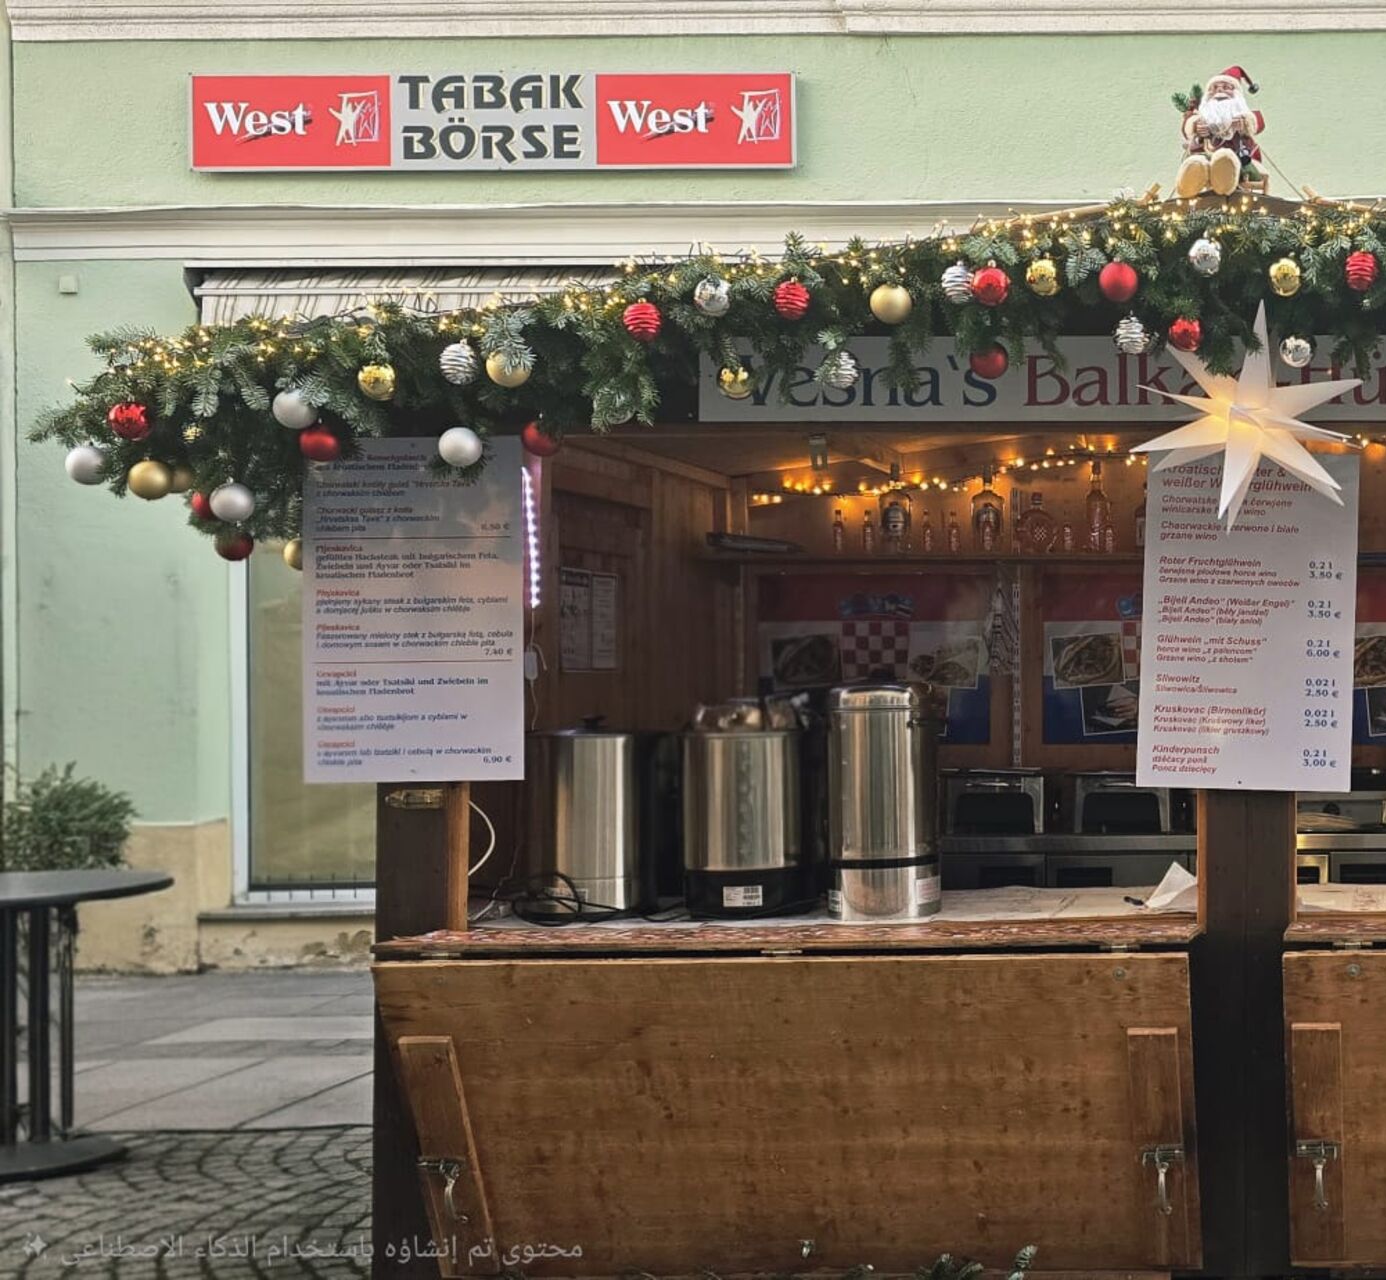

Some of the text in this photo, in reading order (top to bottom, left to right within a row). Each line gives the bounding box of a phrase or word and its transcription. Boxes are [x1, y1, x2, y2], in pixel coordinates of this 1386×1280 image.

[398, 74, 584, 114] TABAK
[204, 101, 308, 136] West
[607, 100, 711, 135] West
[401, 117, 583, 163] BÖRSE
[1162, 477, 1205, 489] weißer
[1195, 533, 1218, 541] wino
[1159, 555, 1186, 565] Roter
[1188, 557, 1262, 568] Fruchtglühwein
[1335, 571, 1343, 580] €
[1333, 611, 1341, 619] €
[1157, 634, 1202, 644] Glühwein
[1332, 650, 1341, 658] €
[1331, 689, 1340, 698] €
[1153, 704, 1205, 713] Kruskovac
[1153, 715, 1197, 724] Kruskovac
[1330, 719, 1338, 728] €
[1152, 744, 1220, 756] Kinderpunsch
[1329, 759, 1337, 768] €
